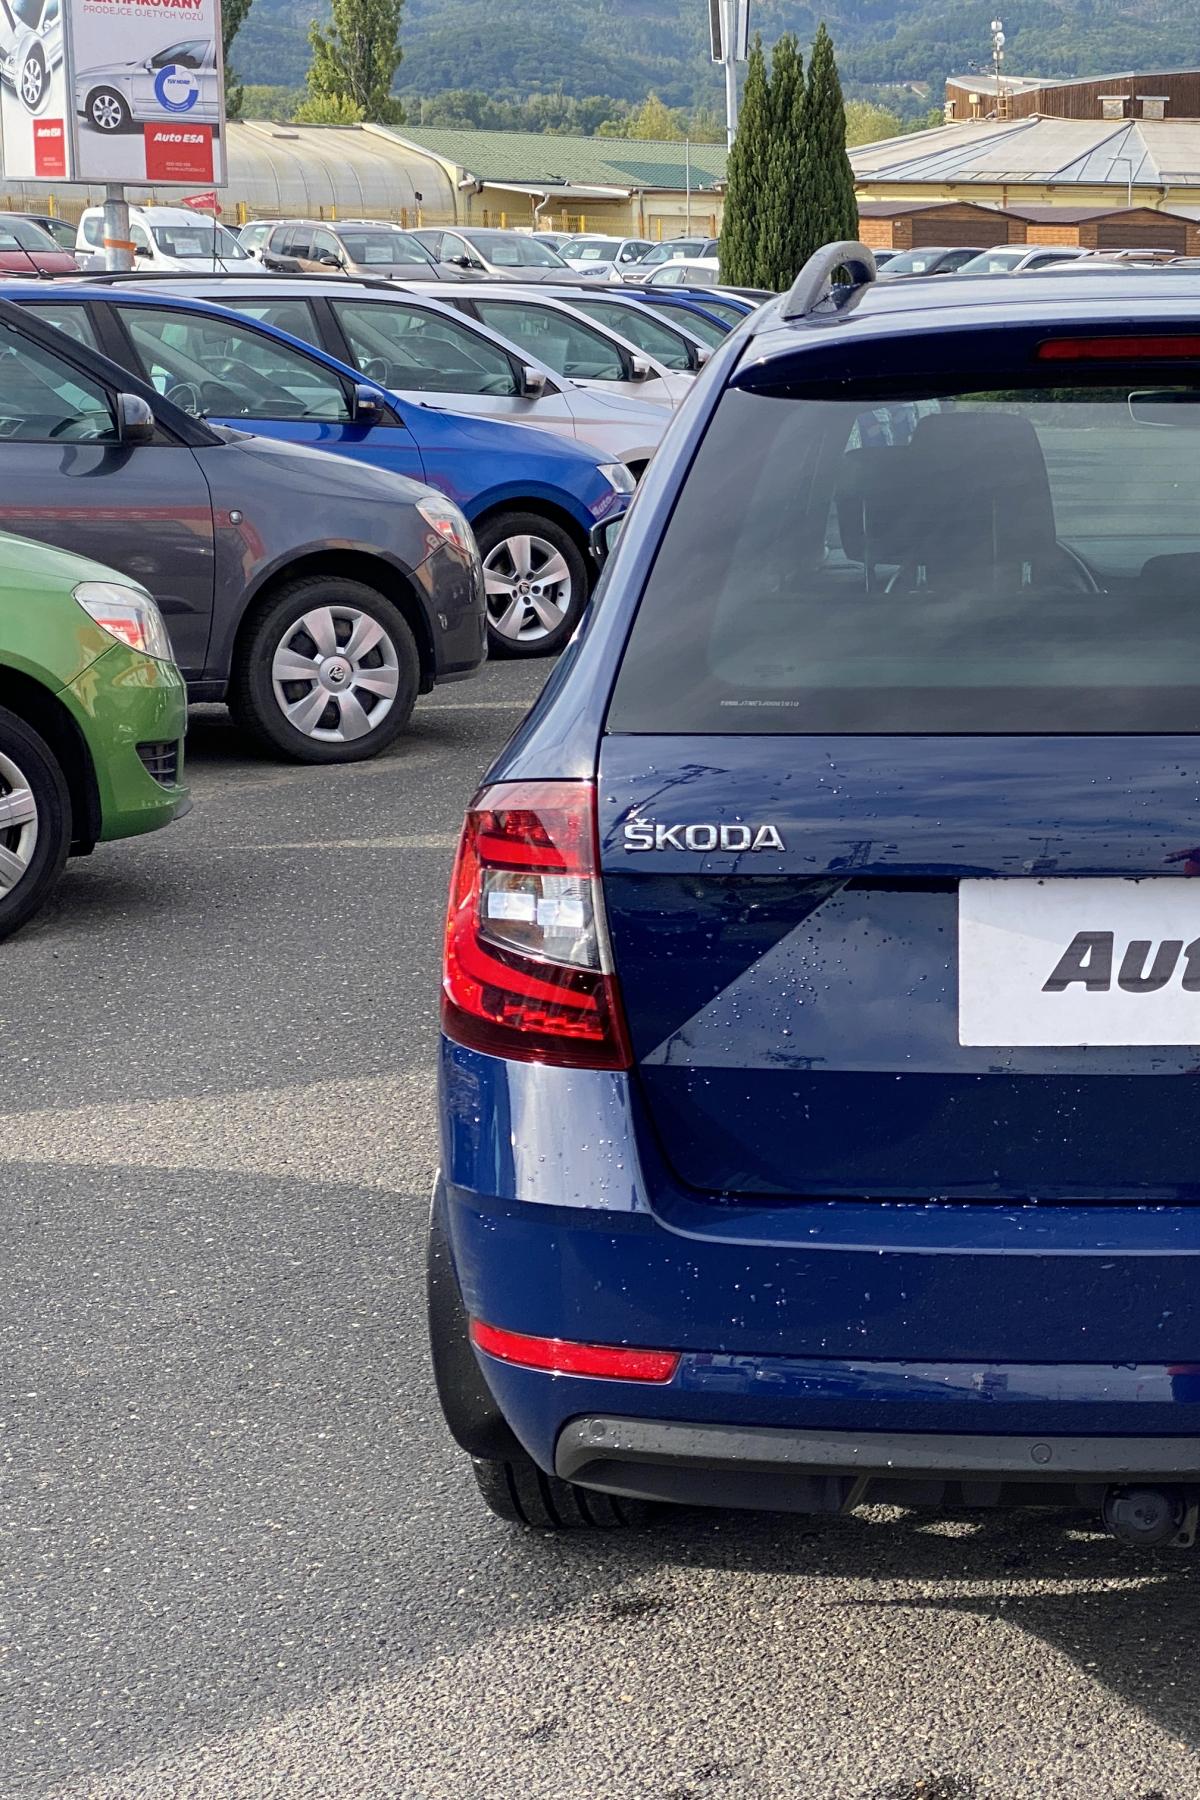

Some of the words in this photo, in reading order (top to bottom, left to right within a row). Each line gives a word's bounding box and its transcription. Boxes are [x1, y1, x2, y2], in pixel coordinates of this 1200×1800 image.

[83, 4, 132, 15] PRODEJCE
[154, 132, 182, 143] Auto
[182, 133, 204, 144] ESA
[622, 818, 786, 852] ŠKODA
